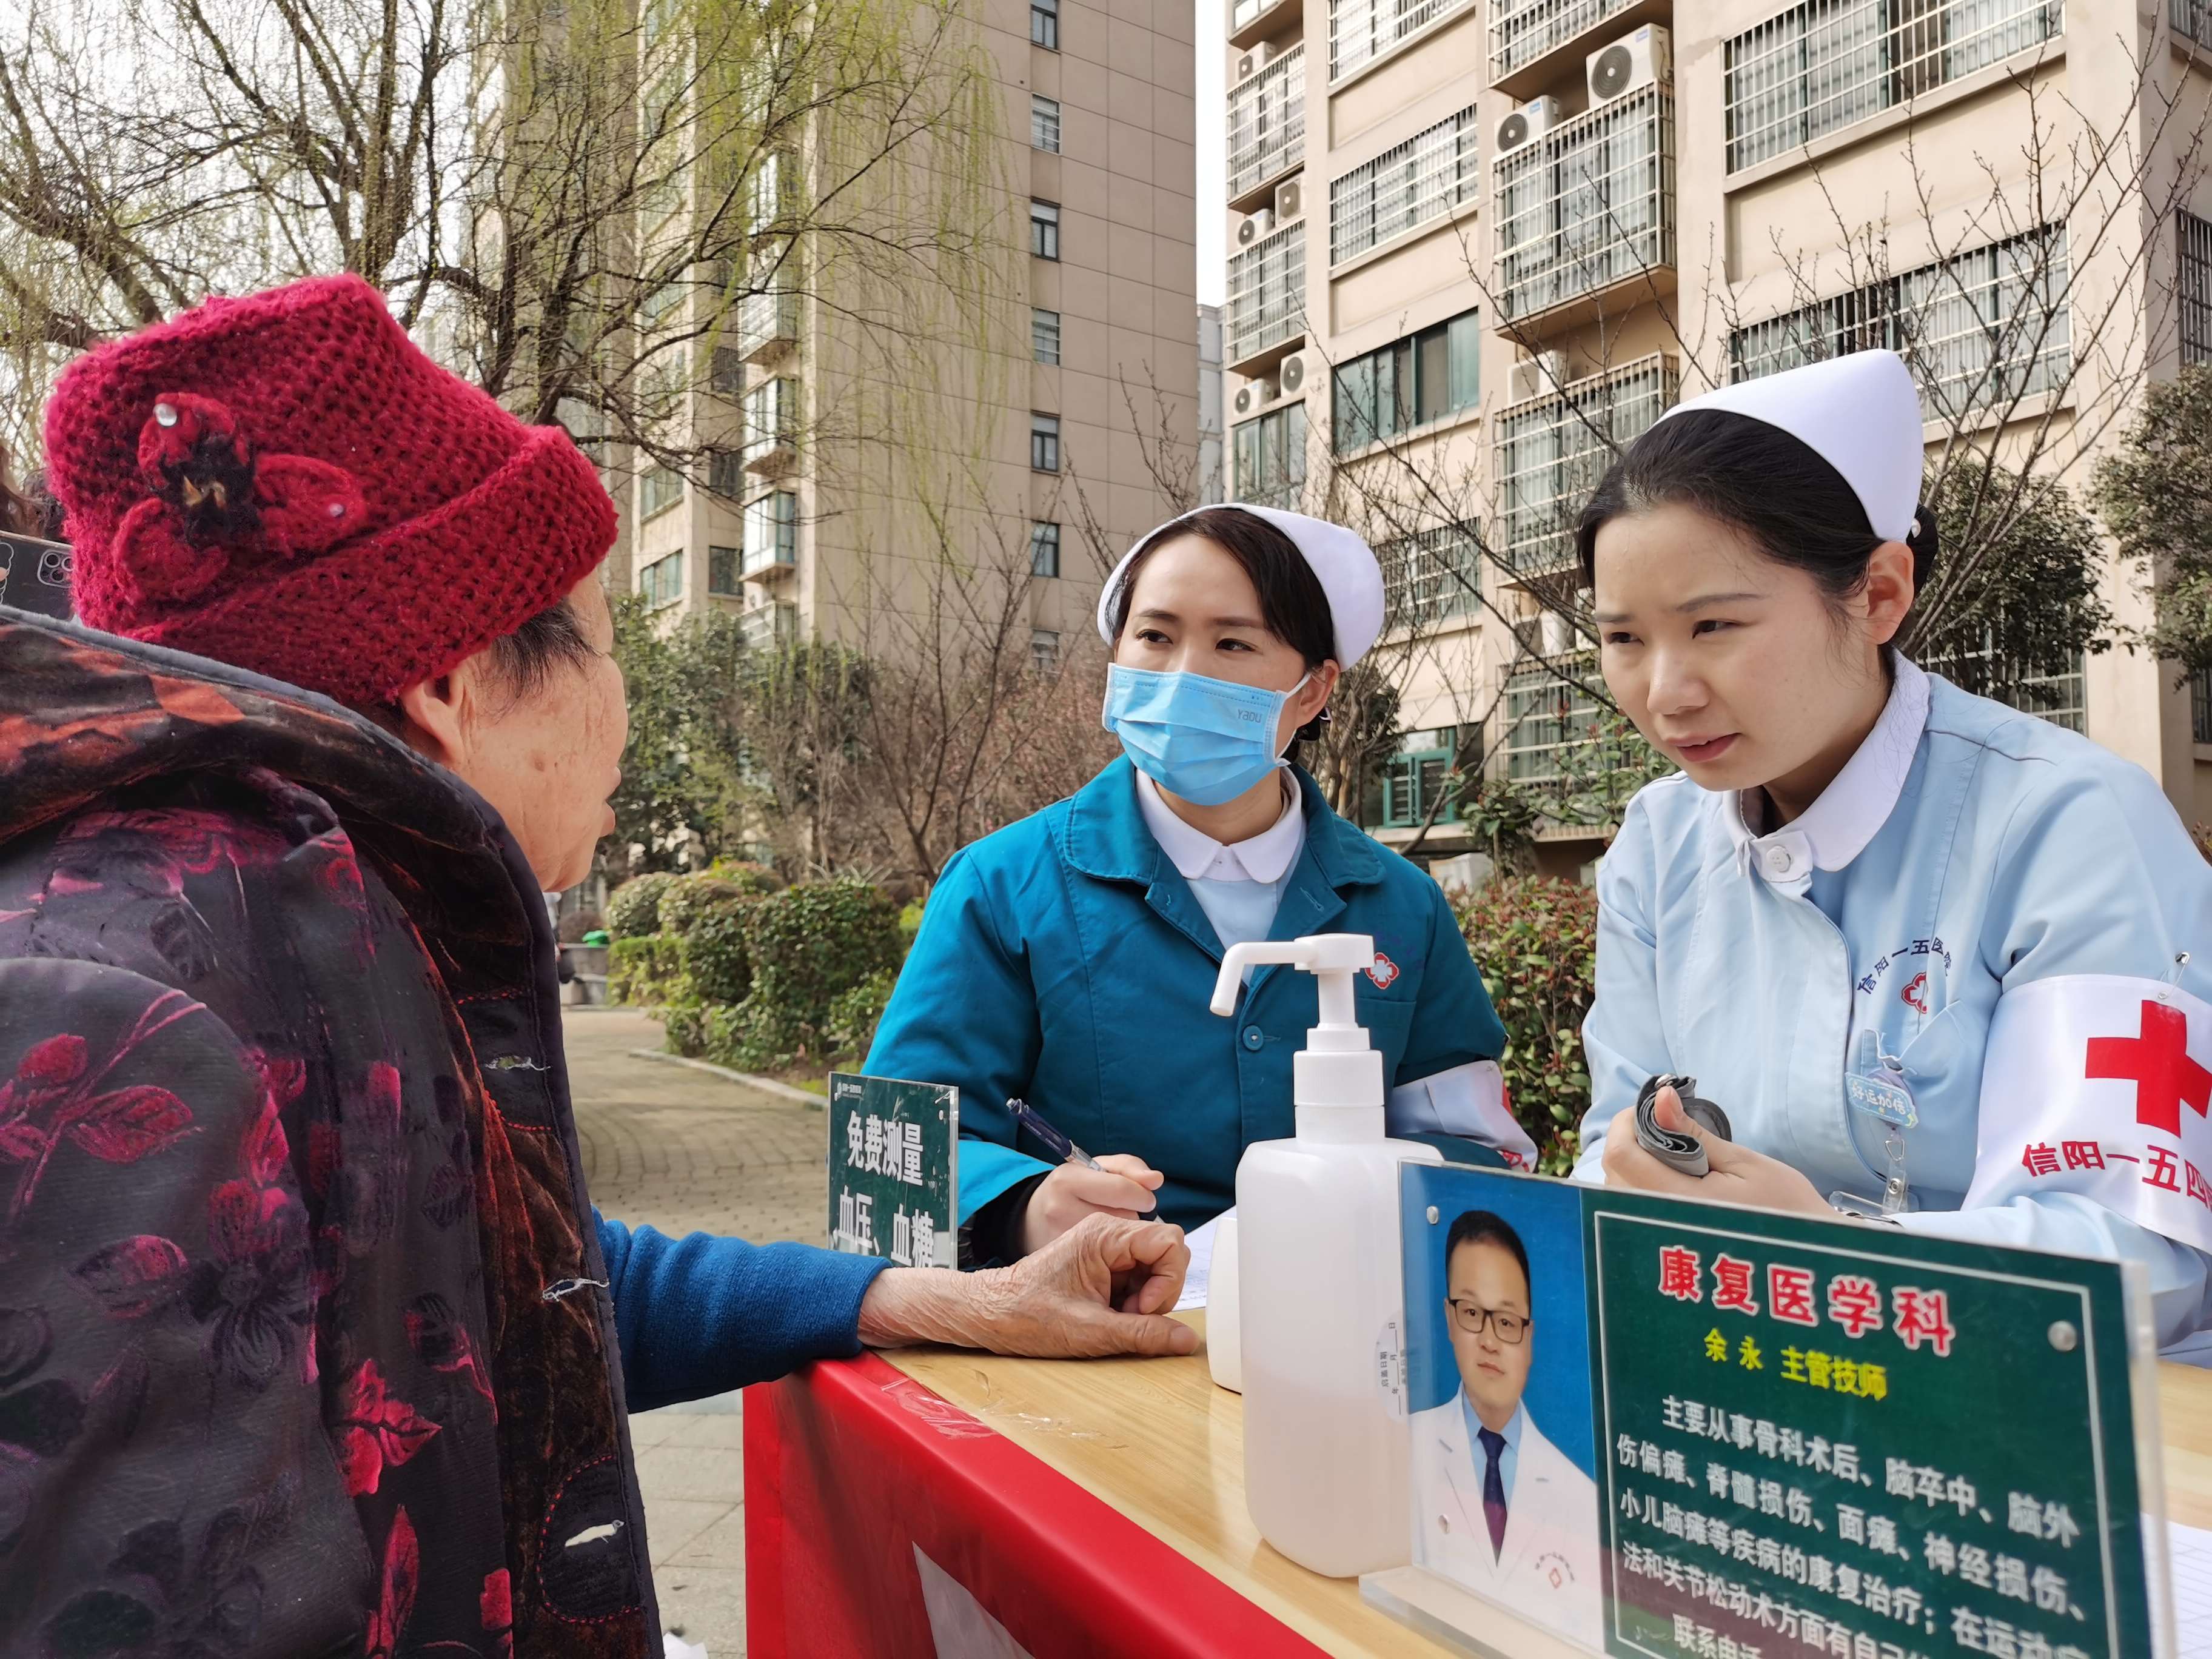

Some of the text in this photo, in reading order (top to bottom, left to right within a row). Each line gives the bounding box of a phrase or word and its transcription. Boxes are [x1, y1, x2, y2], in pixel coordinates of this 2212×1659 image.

[846, 1110, 923, 1186] 免费测量
[2022, 1141, 2212, 1213] 信阳一五四
[1658, 1245, 1956, 1357] 康复医学科
[1780, 1346, 1888, 1401] 主管技师
